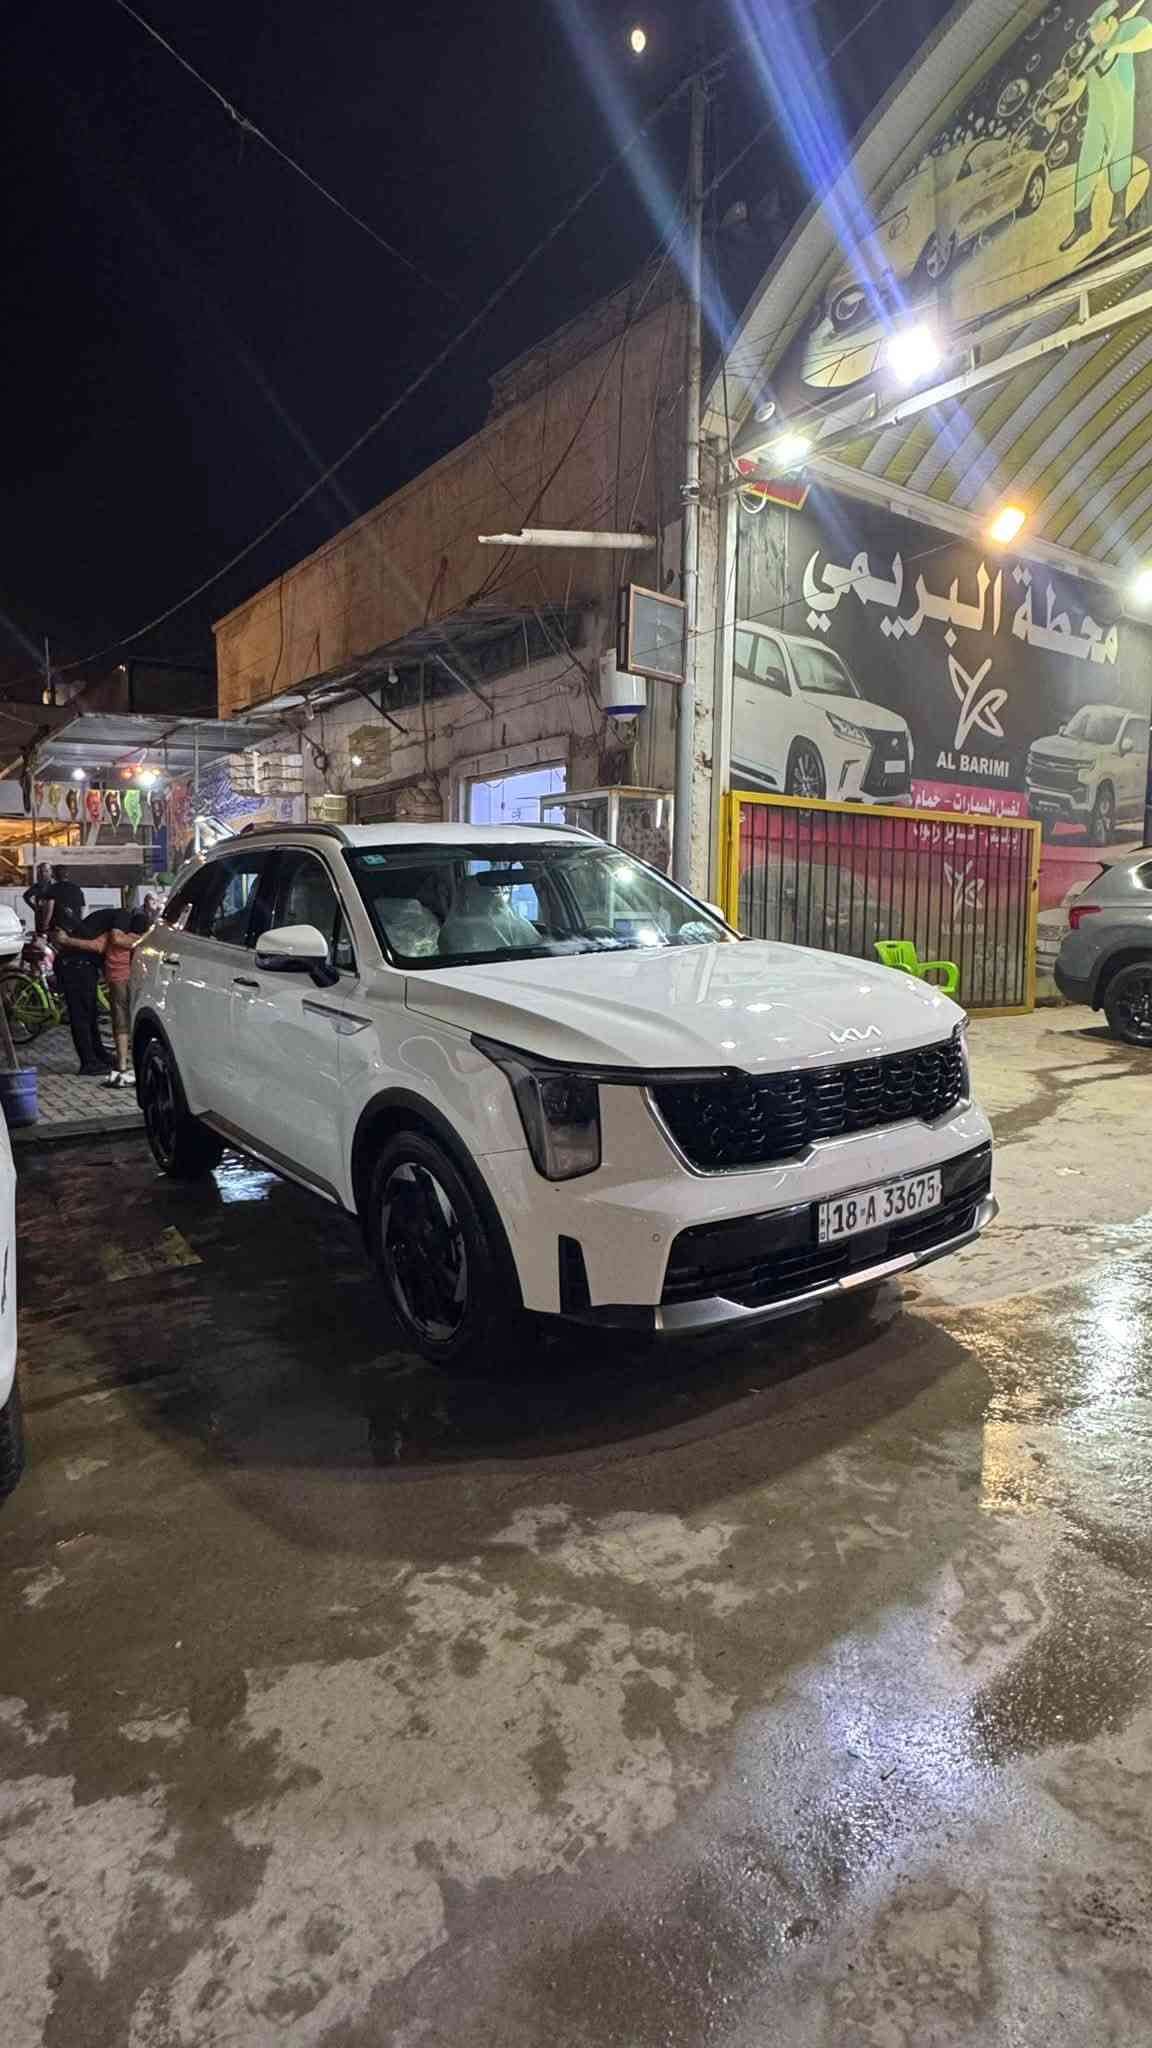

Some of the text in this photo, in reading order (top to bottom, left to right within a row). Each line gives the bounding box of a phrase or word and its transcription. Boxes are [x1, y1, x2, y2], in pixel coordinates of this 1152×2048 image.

[803, 550, 1118, 664] محطة البريمي
[936, 751, 1010, 778] AL BARIMI
[831, 1175, 935, 1235] 18 A 33675
